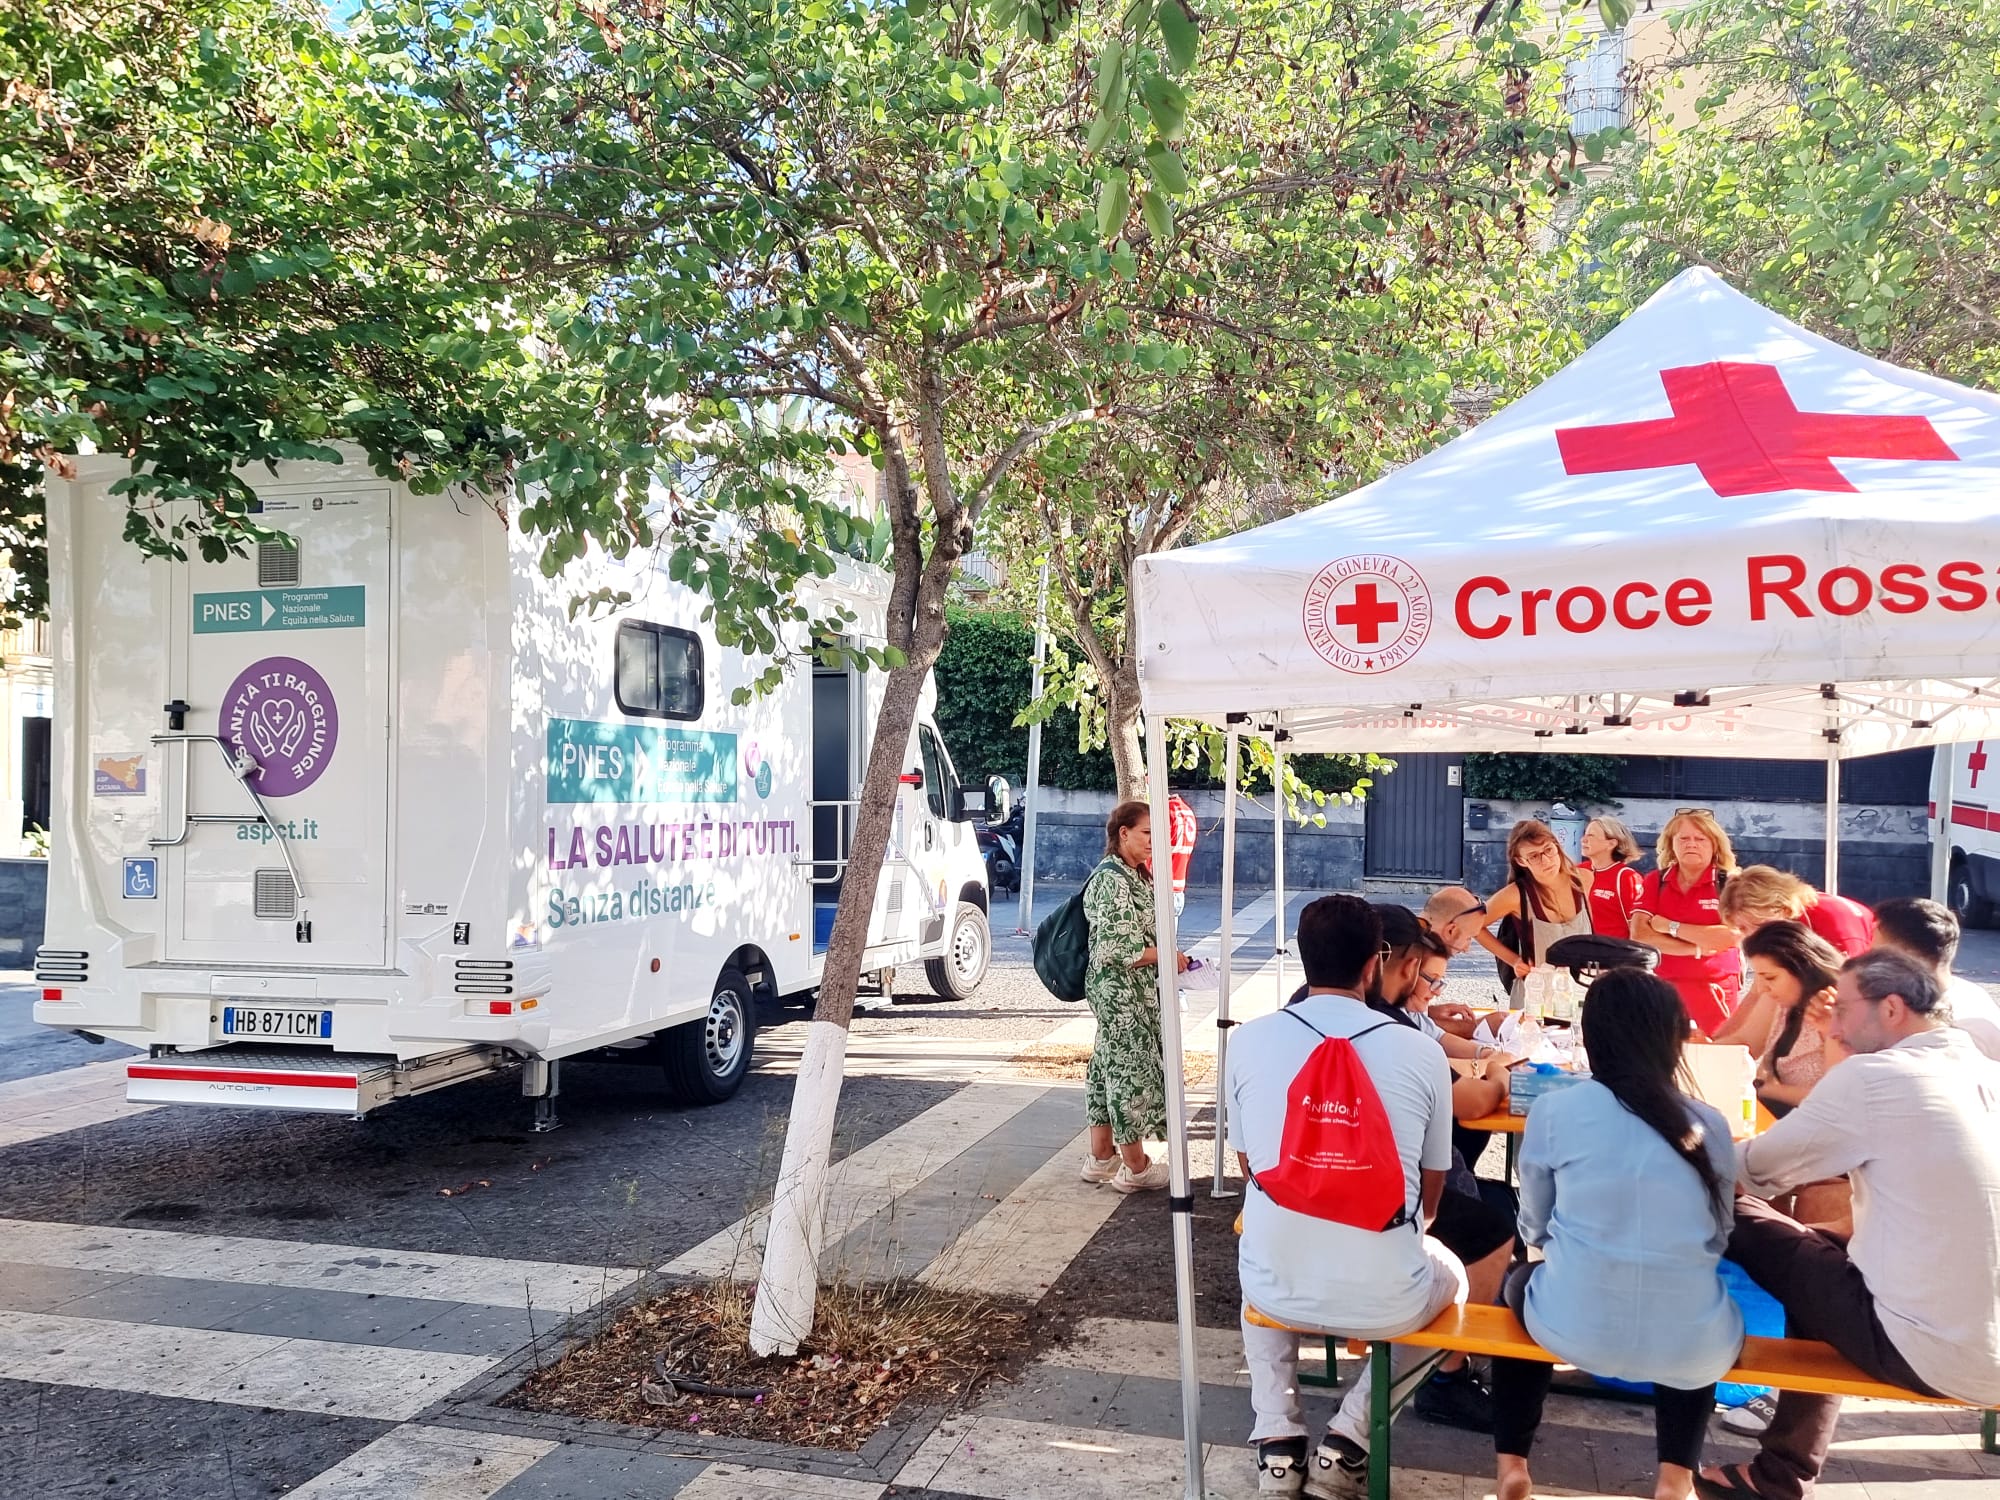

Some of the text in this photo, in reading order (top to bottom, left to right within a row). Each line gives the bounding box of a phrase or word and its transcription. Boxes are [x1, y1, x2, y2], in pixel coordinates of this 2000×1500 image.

[282, 592, 329, 604] Programma
[282, 604, 321, 613] Nazionale
[1455, 554, 2000, 640] Croce Ross
[203, 603, 251, 622] PNES
[282, 614, 355, 626] Equità nella Salute
[1307, 557, 1428, 669] CONVENZIONE DI GINEVRA 22 AGOSTO 1864
[230, 683, 260, 761] SANITÀ
[260, 673, 281, 689] TI
[284, 673, 327, 780] RAGGIUNGE
[658, 736, 704, 755] Programma
[562, 743, 623, 780] PNES
[549, 813, 800, 870] LA SALUTE È DI TUTTI.
[547, 888, 623, 929] Senza
[235, 1010, 318, 1035] HB 871CM
[209, 1084, 273, 1093] AUTOLIFT
